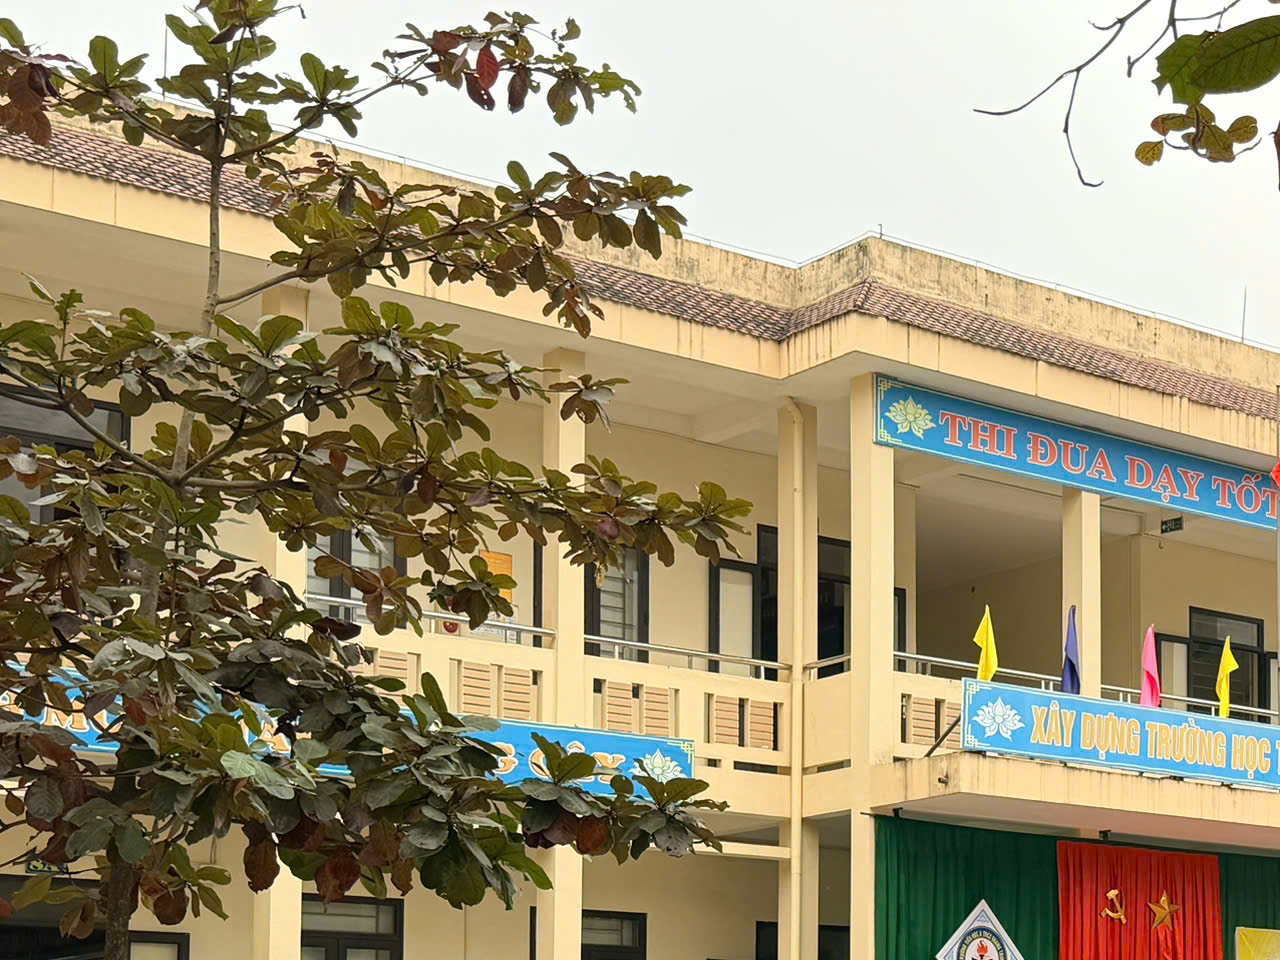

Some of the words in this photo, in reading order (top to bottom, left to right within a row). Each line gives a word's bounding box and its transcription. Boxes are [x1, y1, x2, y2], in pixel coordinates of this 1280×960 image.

[939, 410, 1017, 460] THI
[1026, 431, 1116, 483] ĐUA
[1124, 455, 1204, 503] DẠY
[1031, 701, 1077, 748] XÂY
[1080, 712, 1141, 760] DỰNG
[1146, 717, 1228, 769] TRƯỜNG
[1231, 735, 1272, 779] HỌC
